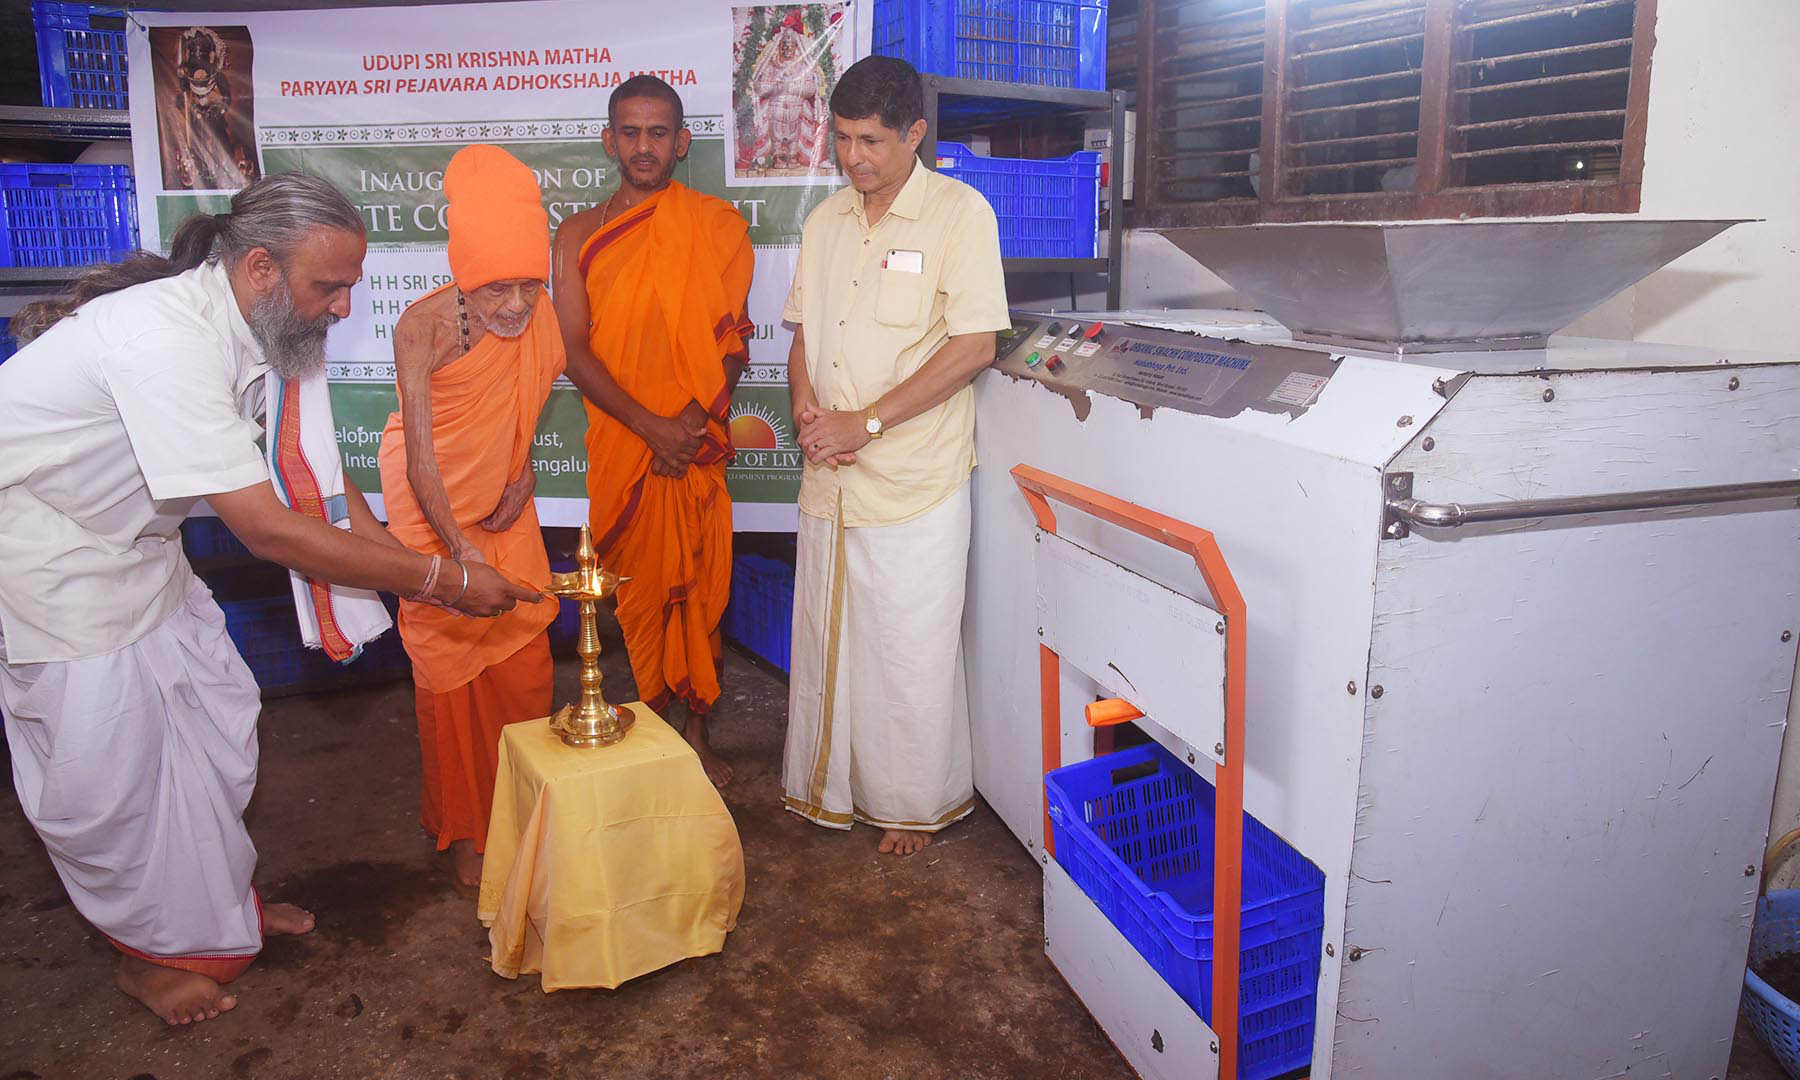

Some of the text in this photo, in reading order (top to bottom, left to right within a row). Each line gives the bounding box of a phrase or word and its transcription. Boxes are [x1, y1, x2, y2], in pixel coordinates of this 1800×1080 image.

[363, 47, 612, 71] UDUPI SRI KRISHNA MATHA
[281, 79, 358, 97] PARYAYA
[363, 78, 391, 95] SRI
[396, 76, 488, 94] PEJAVARA
[493, 72, 622, 91] ADHOKSHAJA
[572, 167, 606, 189] OF
[402, 274, 428, 290] SRI
[744, 452, 768, 467] OF
